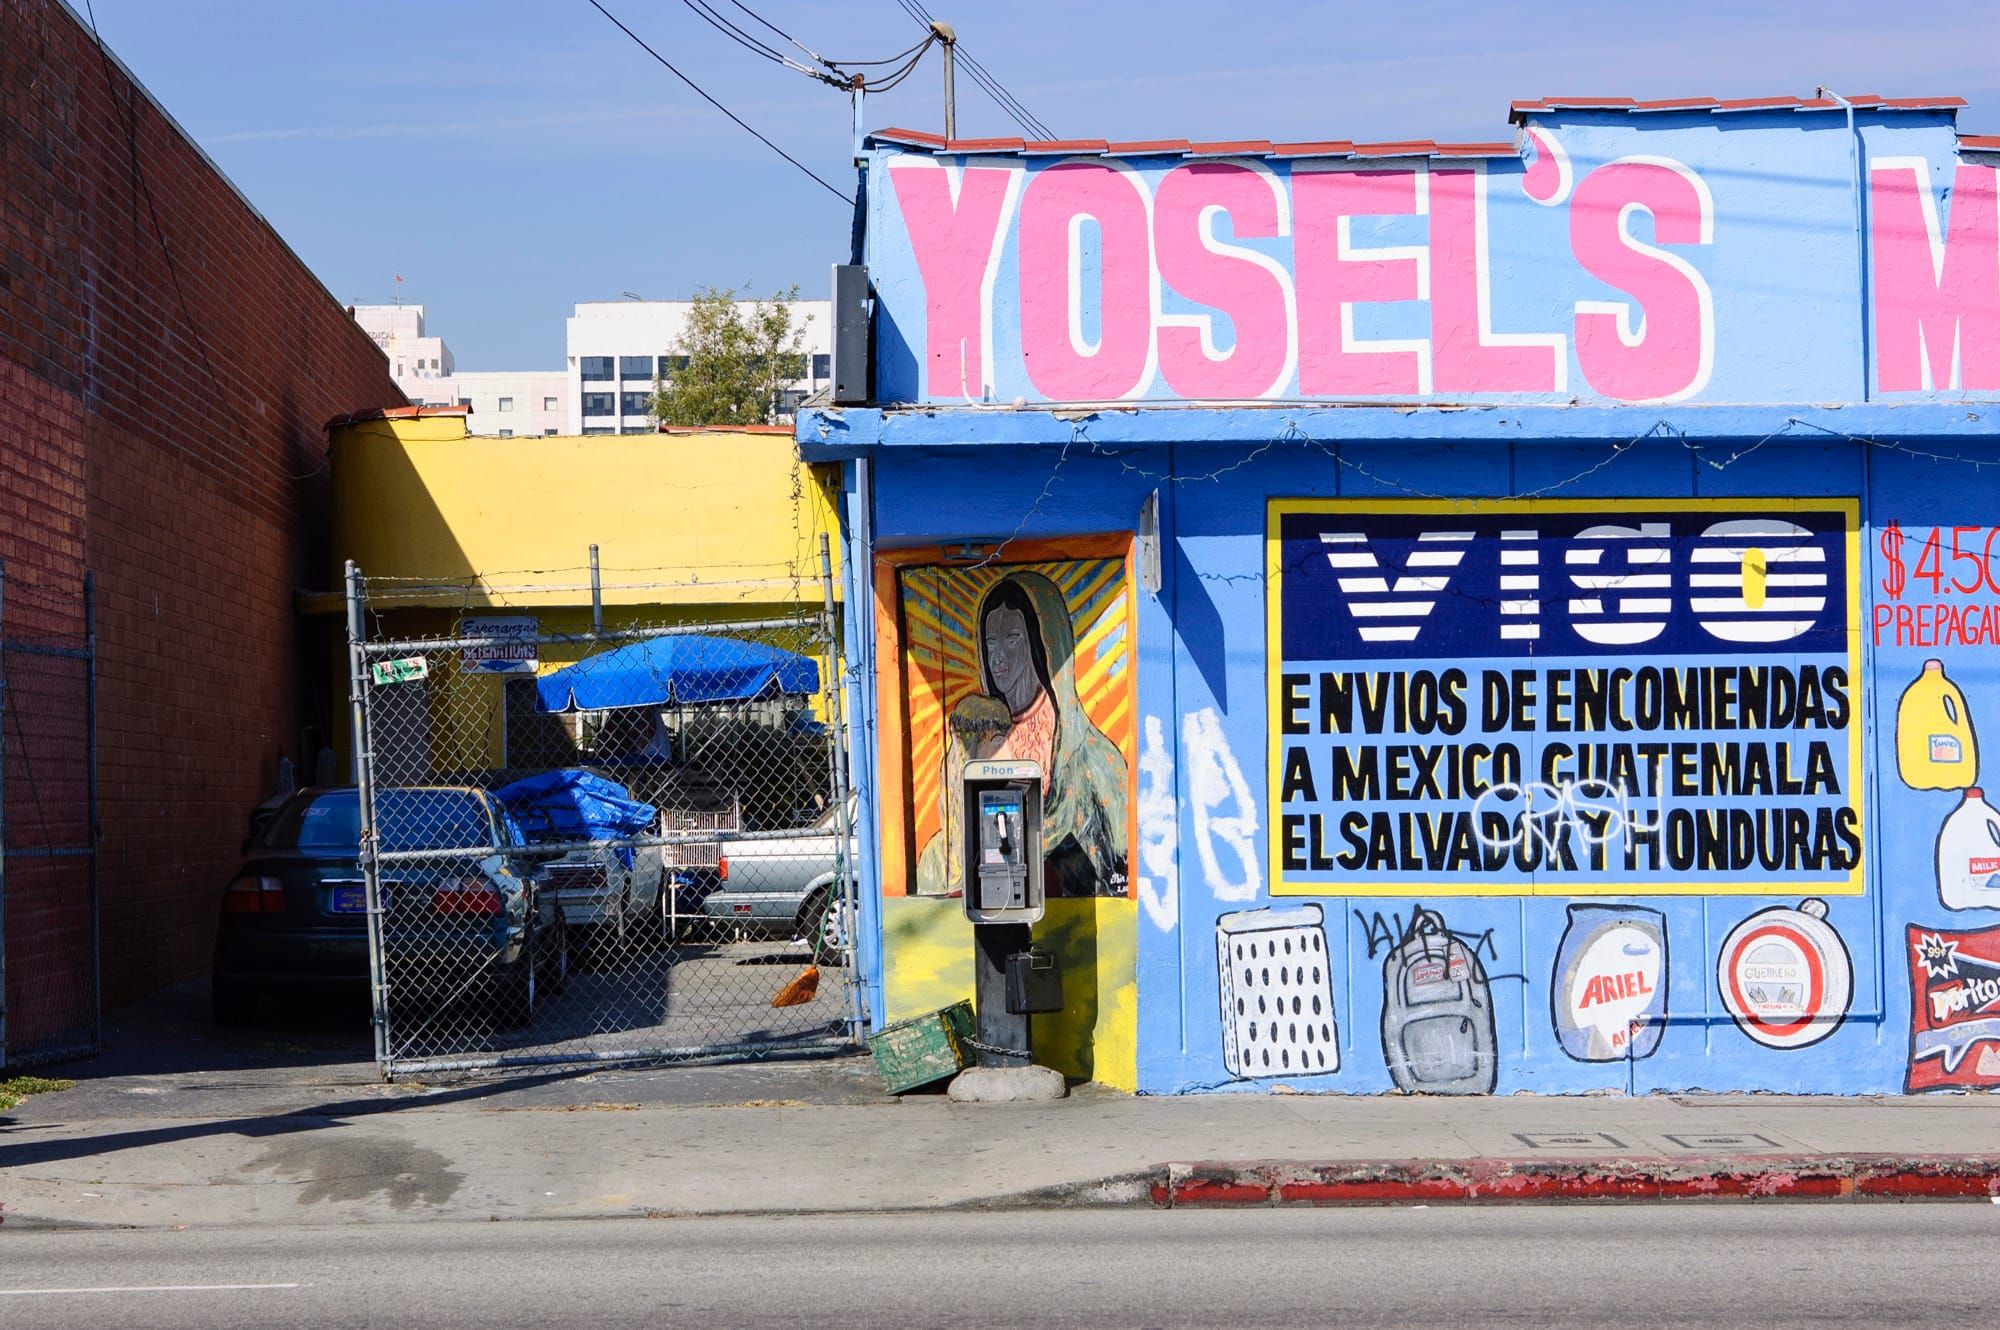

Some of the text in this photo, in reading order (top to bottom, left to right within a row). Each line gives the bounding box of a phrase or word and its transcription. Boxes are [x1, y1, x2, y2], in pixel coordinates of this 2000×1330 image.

[889, 125, 1715, 402] YOSEL'S
[462, 619, 537, 635] Esperanza's
[1281, 664, 1850, 736] ENVIOS DE ENCOMIENDAS
[983, 766, 1014, 775] Phon
[1281, 741, 1842, 802] A MEXICO GUATEMALA
[1623, 806, 1862, 871] HONDURAS
[1971, 862, 1999, 873] MILK
[1578, 970, 1653, 1009] ARIEL
